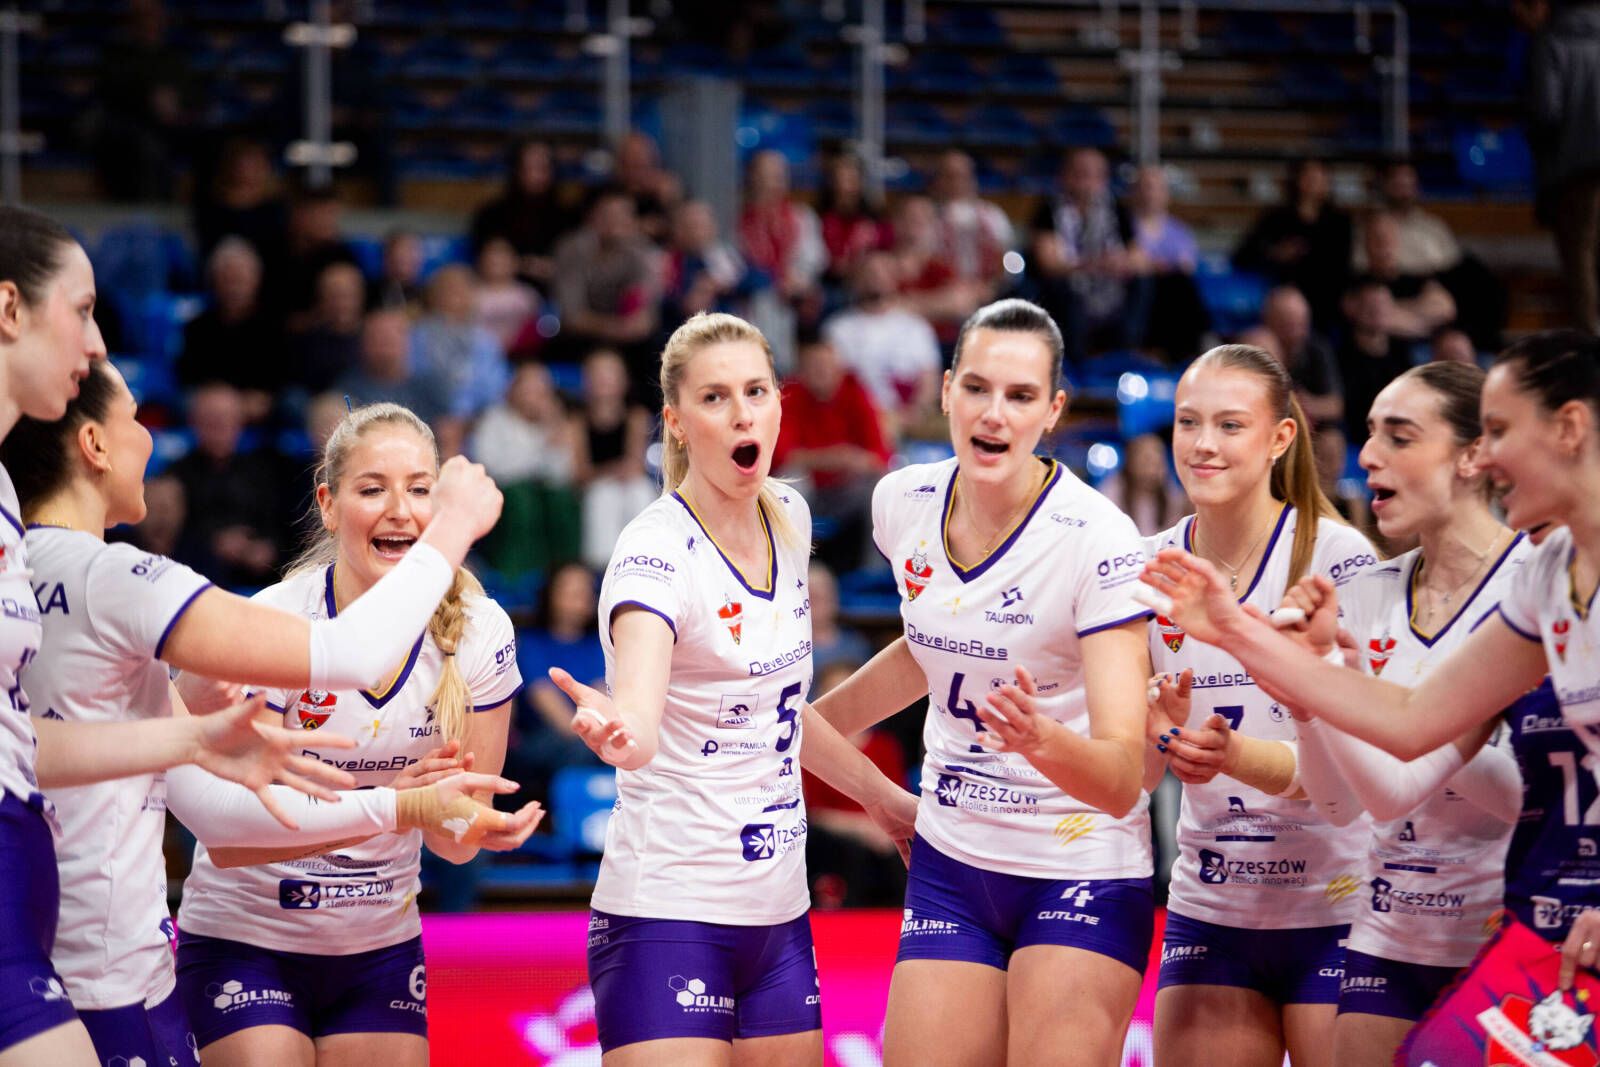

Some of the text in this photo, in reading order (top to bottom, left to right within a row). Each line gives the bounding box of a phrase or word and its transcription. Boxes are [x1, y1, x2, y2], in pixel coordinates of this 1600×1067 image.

[622, 554, 676, 573] PGOP
[1113, 551, 1147, 571] PGO
[1343, 553, 1377, 572] PGO
[985, 610, 1034, 625] TAURON
[906, 622, 1009, 661] DevelopRes
[748, 639, 812, 676] DevelopRe
[775, 681, 802, 753] 5
[409, 727, 441, 739] TAUR
[302, 749, 419, 772] DevelopRe
[1227, 858, 1307, 875] rzeszów
[1059, 880, 1095, 908] 4
[1037, 910, 1101, 927] CUTLINE
[1161, 944, 1208, 965] LIMP
[408, 963, 427, 1001] 6
[1340, 976, 1388, 992] LIMP
[232, 988, 293, 1005] OLIMP
